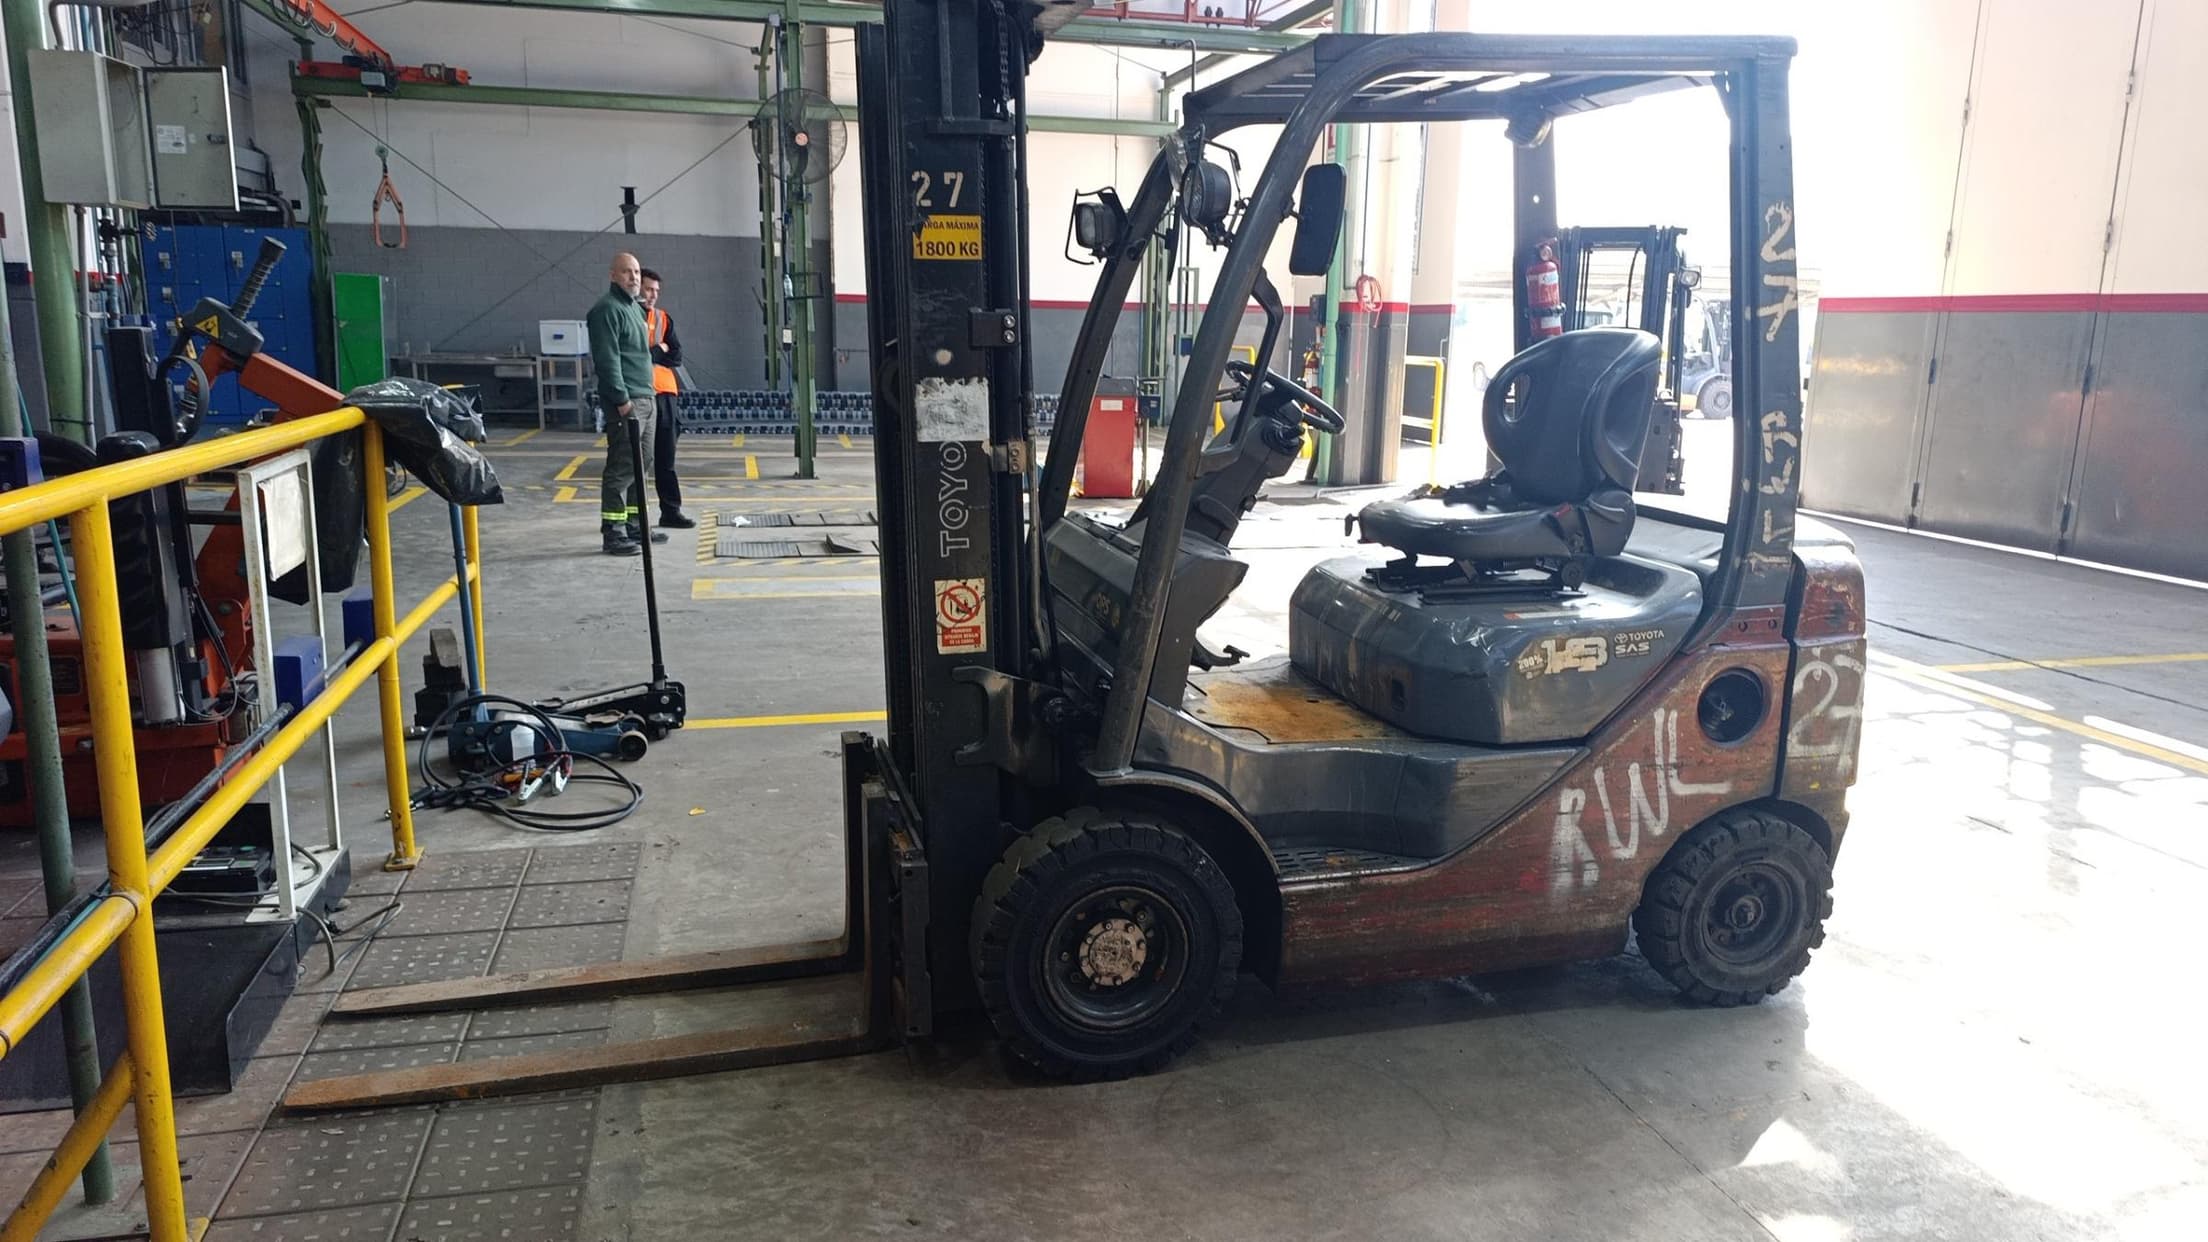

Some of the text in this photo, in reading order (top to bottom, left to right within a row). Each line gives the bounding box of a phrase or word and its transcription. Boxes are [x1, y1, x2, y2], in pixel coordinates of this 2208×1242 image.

[916, 241, 979, 256] 1800 KG
[1628, 629, 1665, 641] TOYOTA
[1615, 642, 1650, 653] SAS
